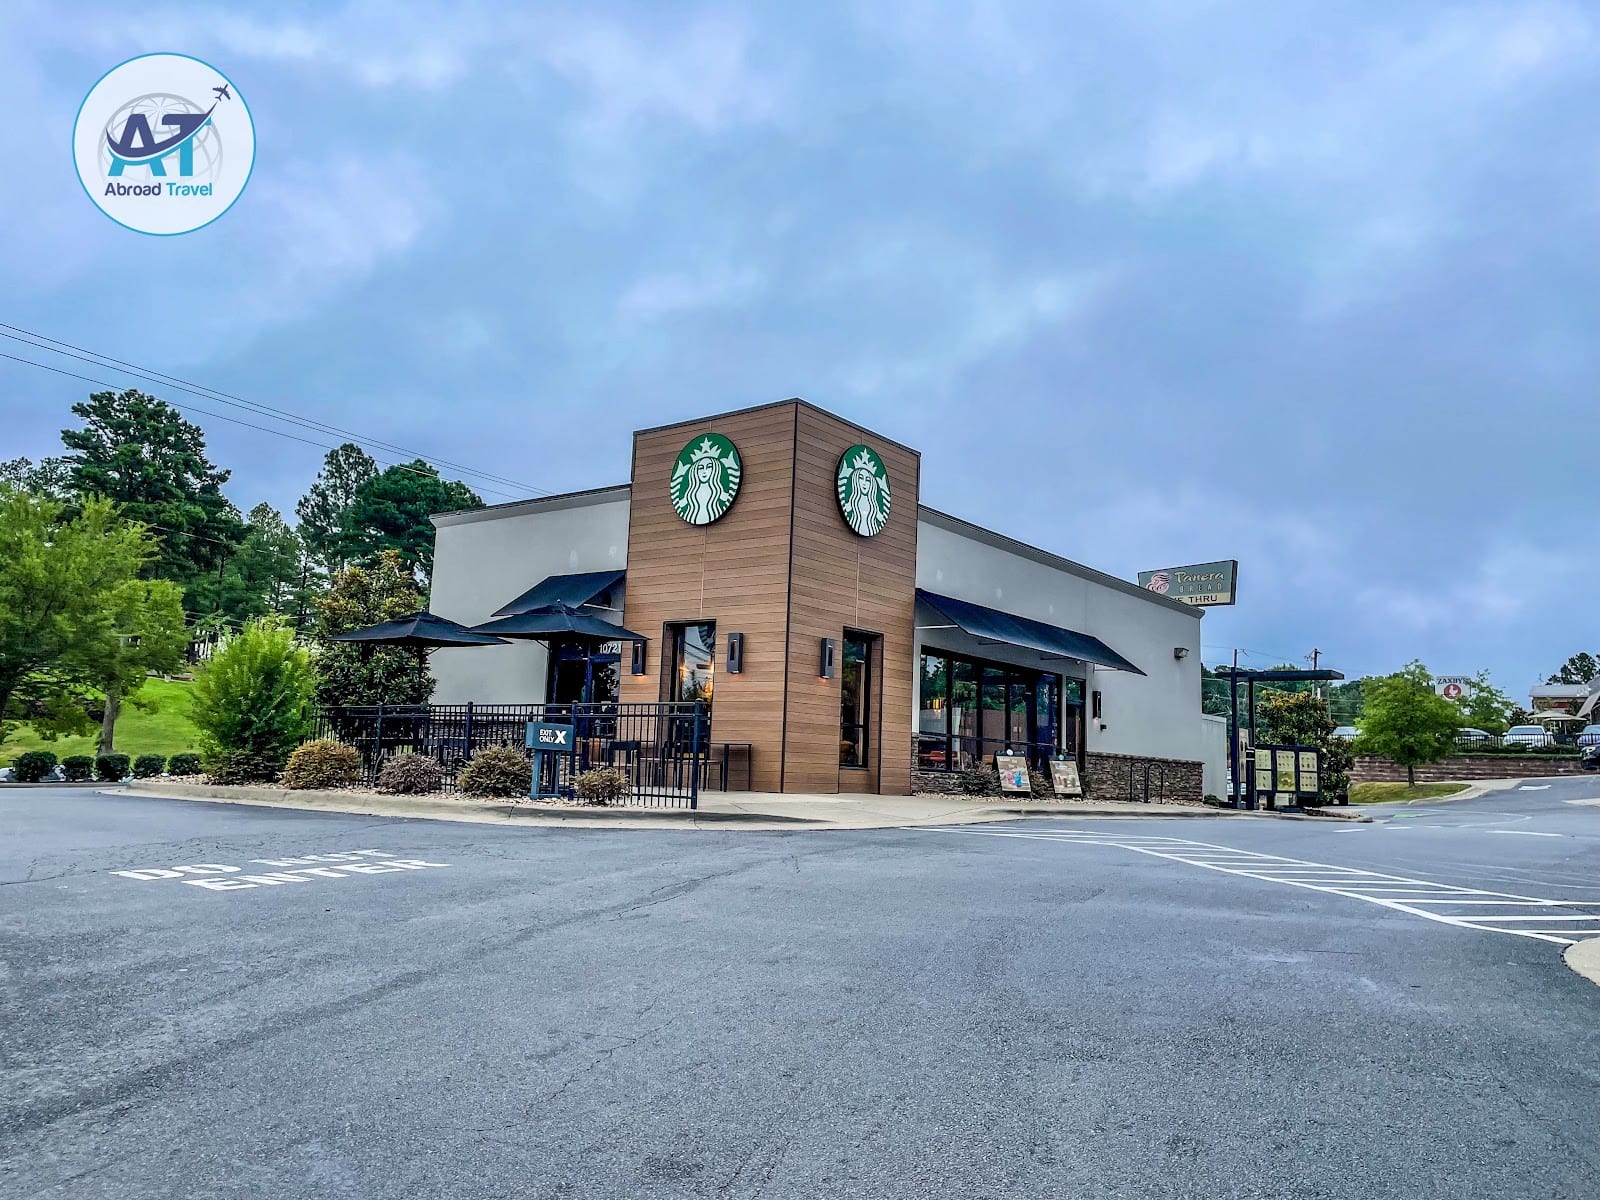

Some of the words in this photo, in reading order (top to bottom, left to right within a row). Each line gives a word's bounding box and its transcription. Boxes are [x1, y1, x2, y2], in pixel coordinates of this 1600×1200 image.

[1174, 571, 1224, 583] Panera
[1179, 583, 1222, 592] BREAD
[1189, 595, 1218, 603] THRU
[109, 863, 242, 880] DO
[248, 849, 398, 867] NOT
[182, 860, 452, 890] ENTER
